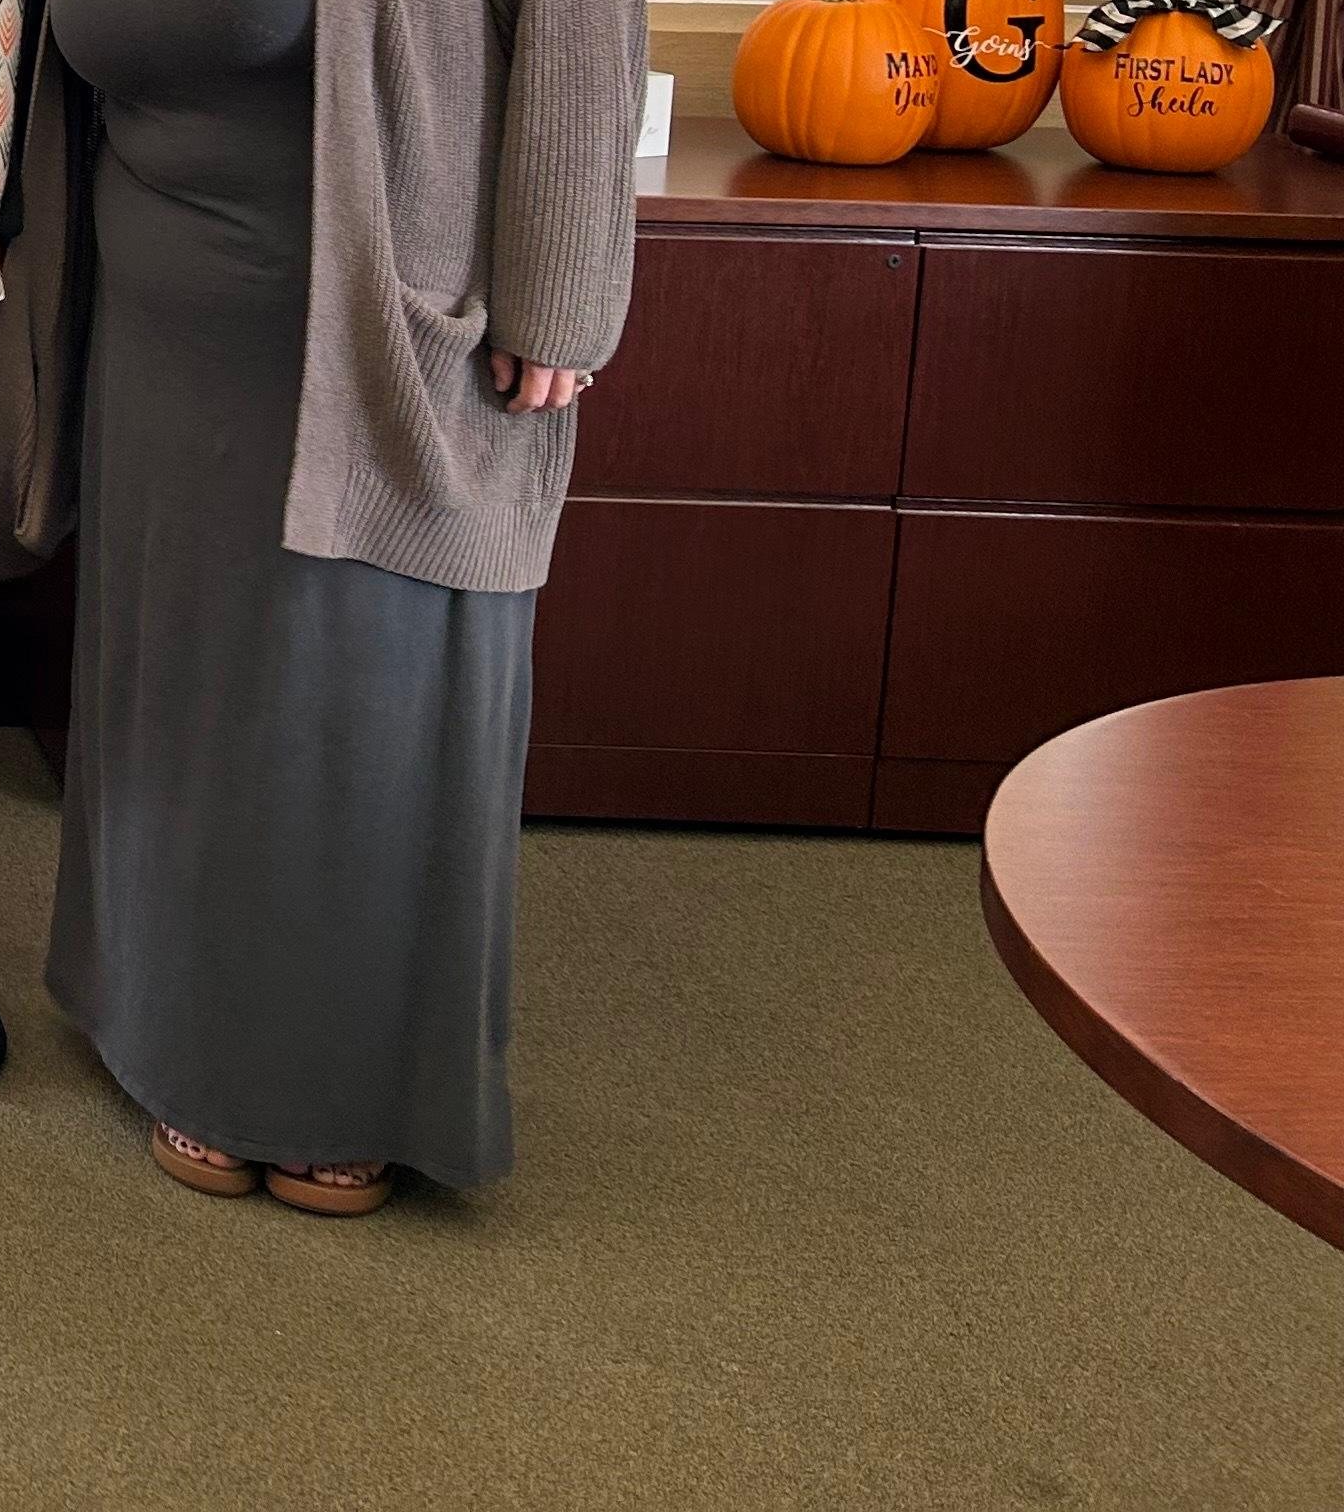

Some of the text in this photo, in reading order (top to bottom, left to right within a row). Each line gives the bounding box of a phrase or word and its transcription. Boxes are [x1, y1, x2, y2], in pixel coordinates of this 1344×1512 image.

[942, 25, 1042, 68] Goins
[885, 52, 938, 80] MAYO
[1114, 53, 1234, 85] FIRST LADY
[1127, 82, 1218, 117] Sheila
